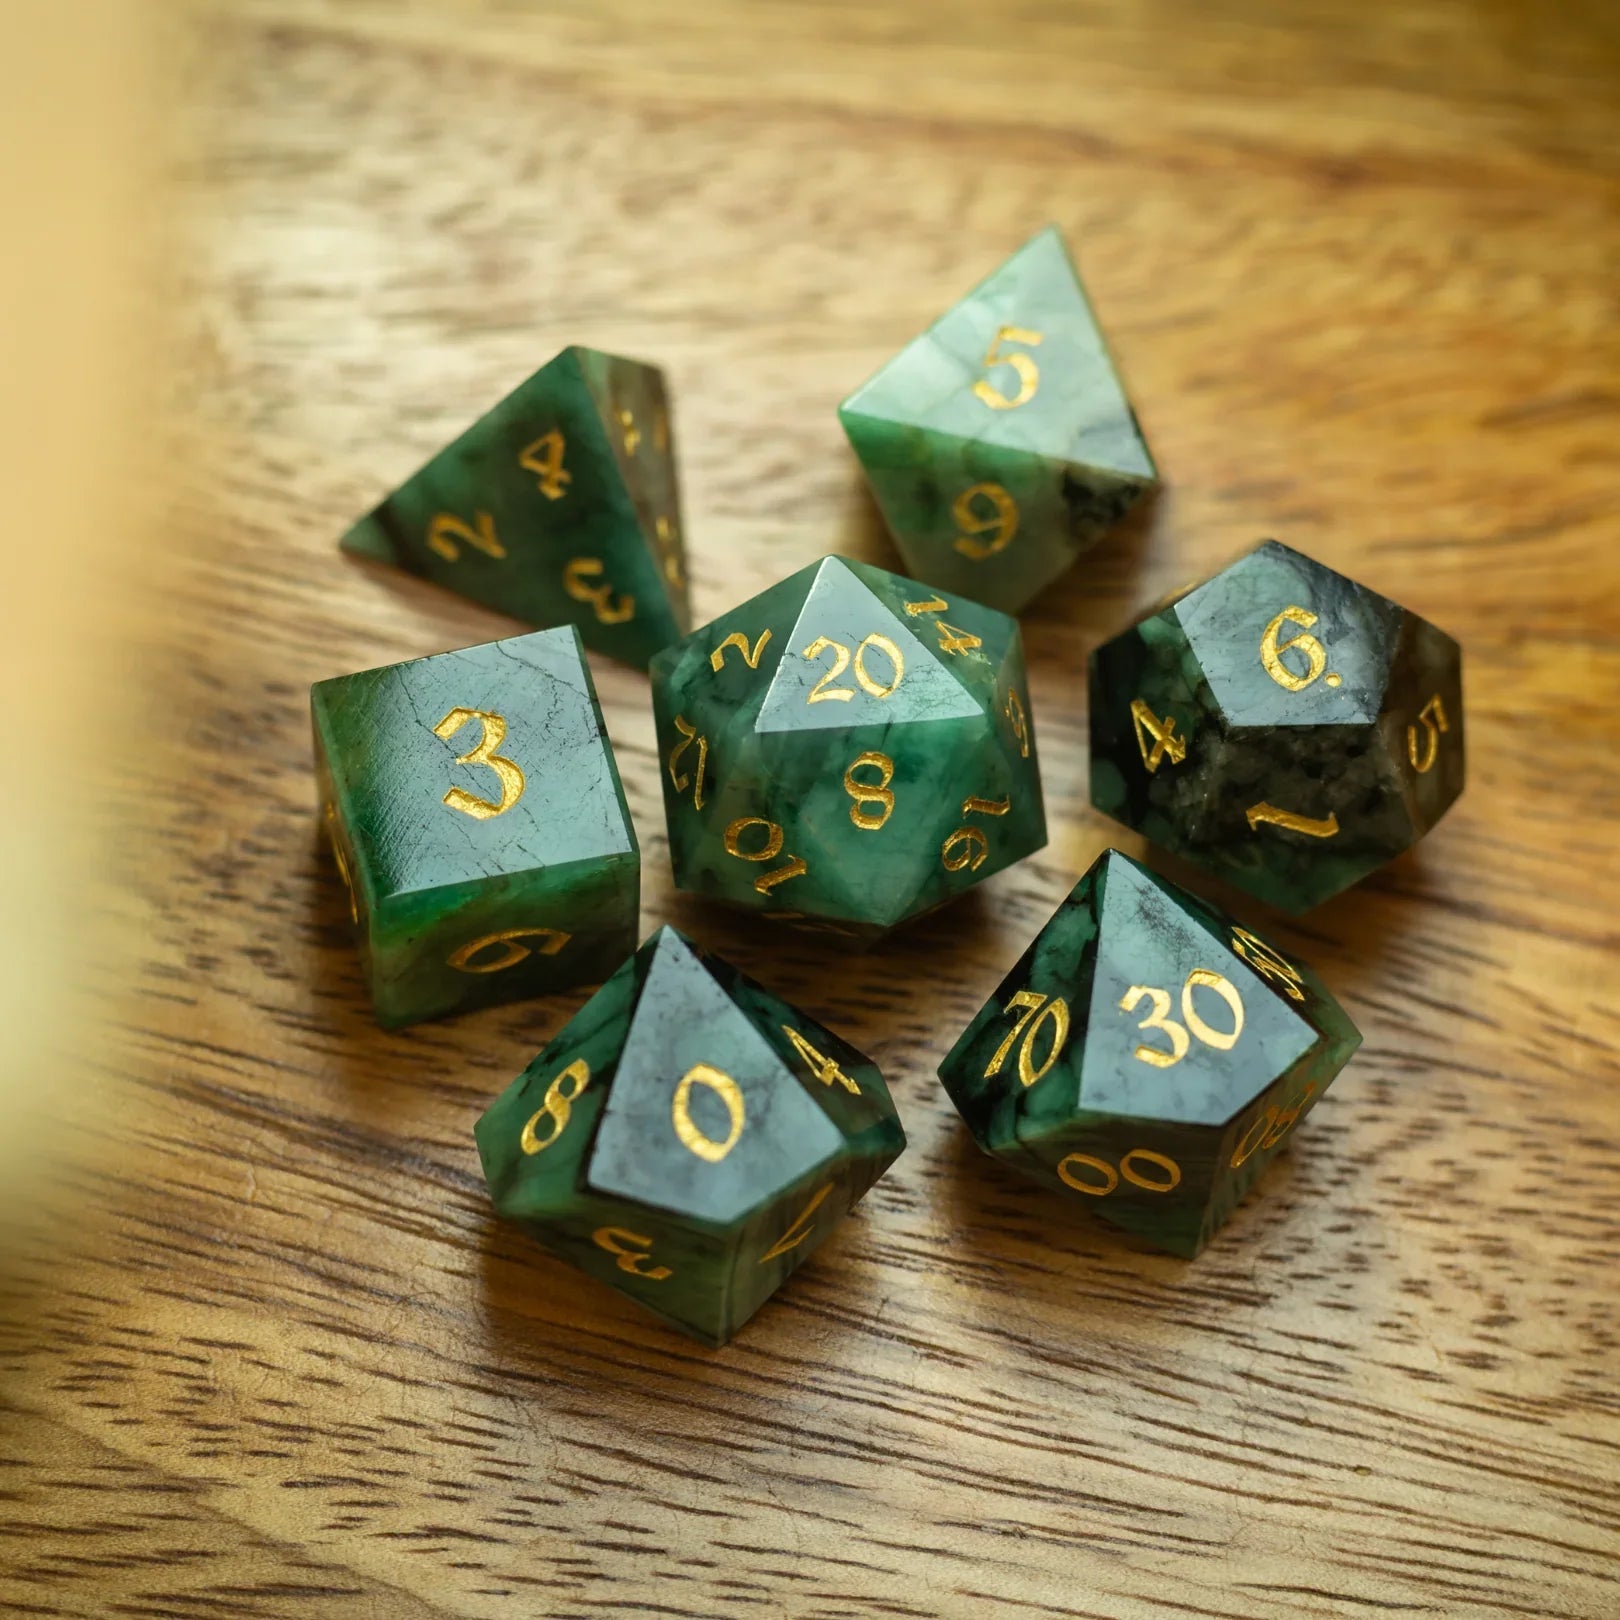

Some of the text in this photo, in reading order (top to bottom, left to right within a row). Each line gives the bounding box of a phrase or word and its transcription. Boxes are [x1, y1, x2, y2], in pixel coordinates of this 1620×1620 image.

[972, 325, 1043, 410] 5
[517, 427, 572, 500] 4
[427, 510, 507, 562] 2
[564, 557, 636, 625] 3
[904, 595, 982, 656] 14
[710, 628, 772, 672] 2
[803, 632, 904, 704] 20
[433, 706, 526, 821] 3
[1130, 699, 1186, 773] 4
[1407, 694, 1448, 773] 5
[844, 751, 895, 831] 8
[1245, 801, 1340, 838] 1
[446, 928, 572, 973] 6
[983, 990, 1070, 1088] 70
[1119, 968, 1245, 1069] 30
[781, 1024, 862, 1095] 4
[520, 1058, 591, 1156] 8
[672, 1062, 746, 1163] 0
[1057, 1148, 1181, 1196] 00
[593, 1226, 674, 1281] 3
